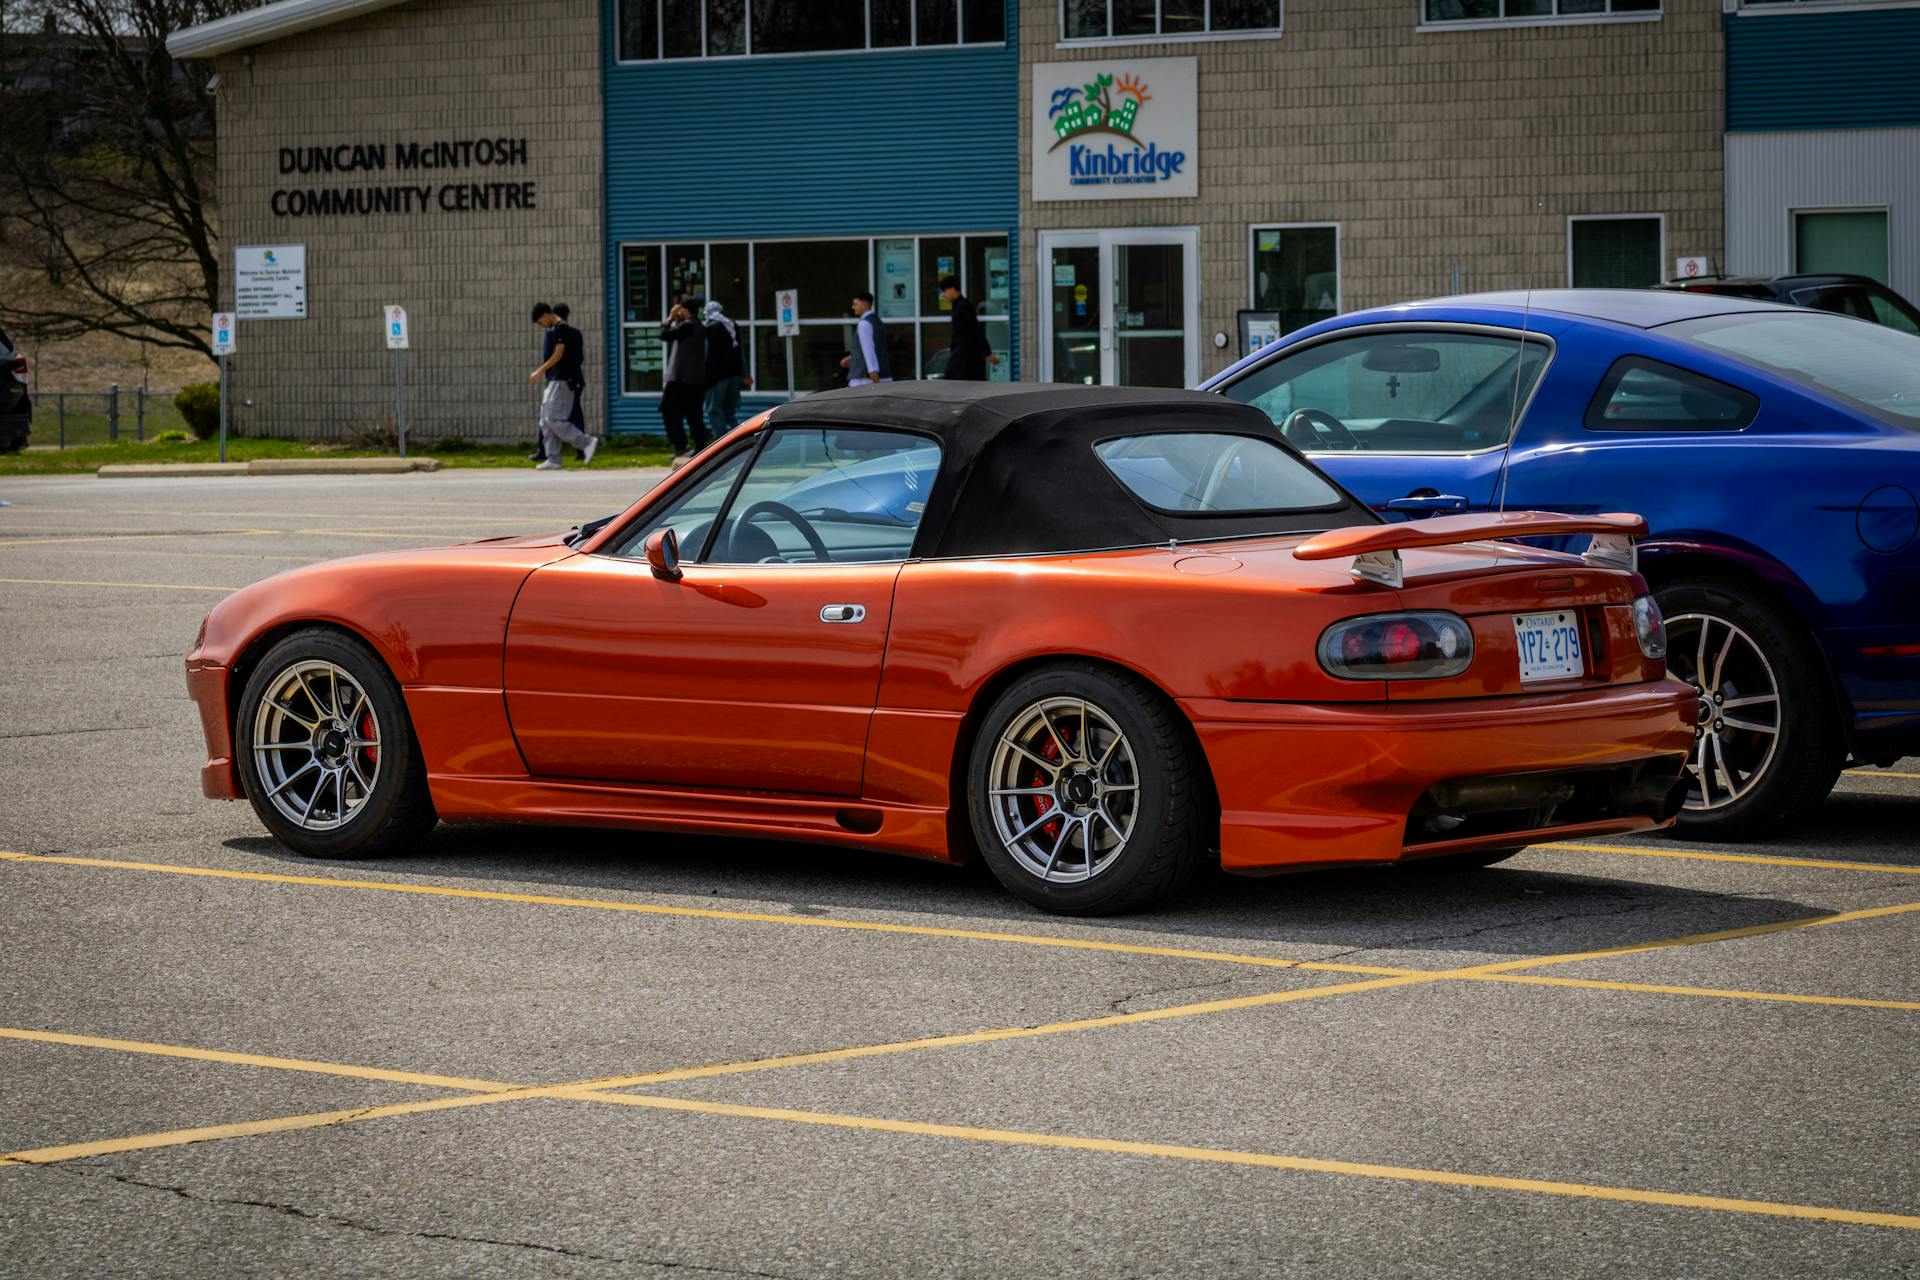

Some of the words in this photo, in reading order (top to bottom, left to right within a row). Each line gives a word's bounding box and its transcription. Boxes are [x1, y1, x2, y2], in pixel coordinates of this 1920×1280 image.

[279, 144, 386, 174] DUNCAN
[395, 138, 527, 170] McINTOSH
[1070, 142, 1186, 180] Kinbridge
[271, 186, 433, 216] COMMUNITY
[438, 182, 536, 211] CENTRE
[1526, 616, 1555, 629] ONTARIO
